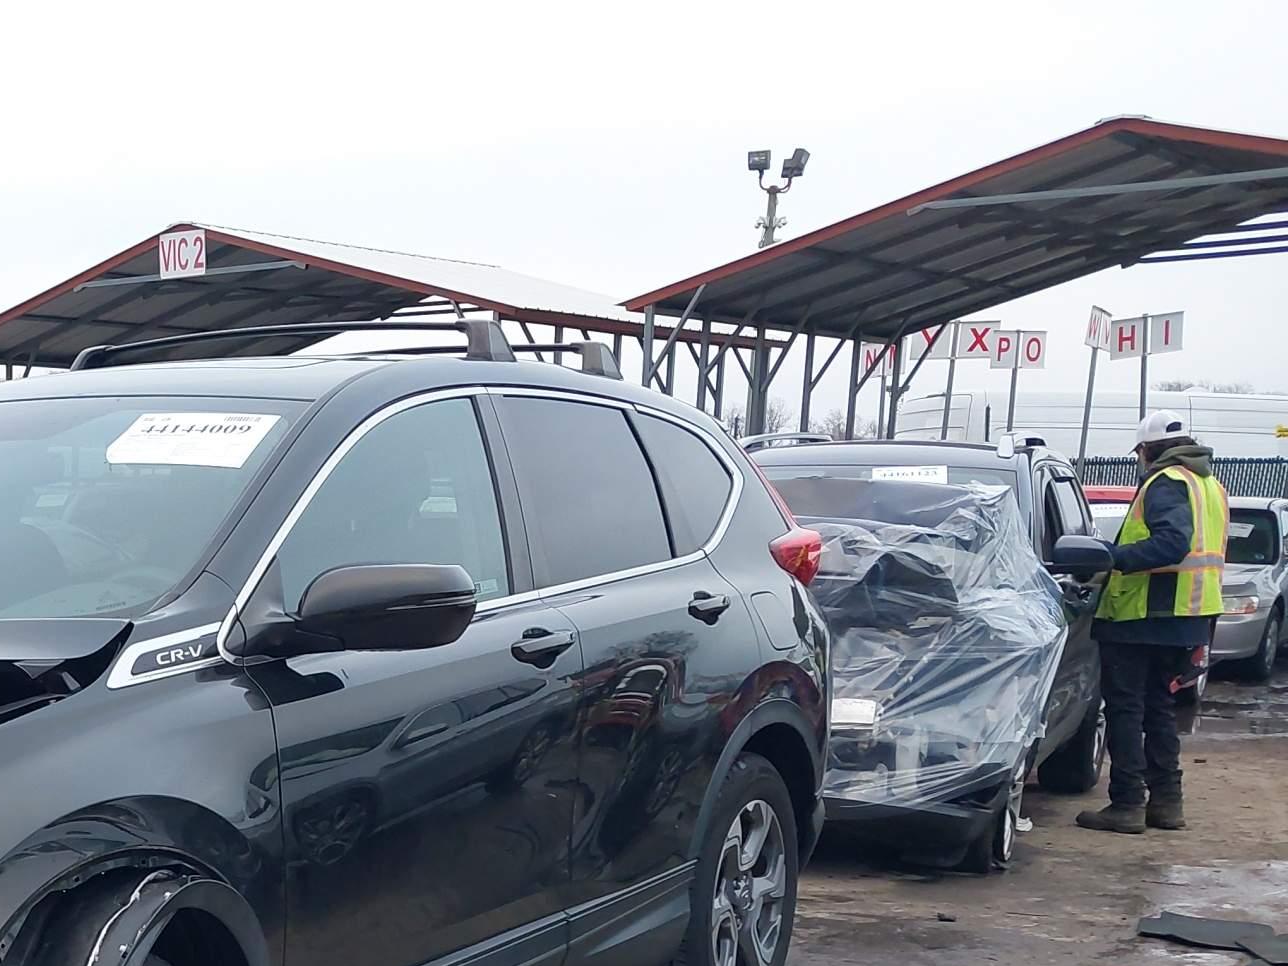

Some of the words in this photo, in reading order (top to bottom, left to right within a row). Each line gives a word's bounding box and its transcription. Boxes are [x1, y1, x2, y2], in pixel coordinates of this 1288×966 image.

[160, 237, 189, 272] VIC
[193, 236, 205, 269] 2
[967, 327, 992, 352] X
[1118, 325, 1136, 352] H
[1164, 319, 1170, 345] I
[997, 337, 1011, 362] P
[1026, 337, 1042, 362] O
[140, 424, 253, 434] 44144009
[156, 644, 202, 665] CR-V
